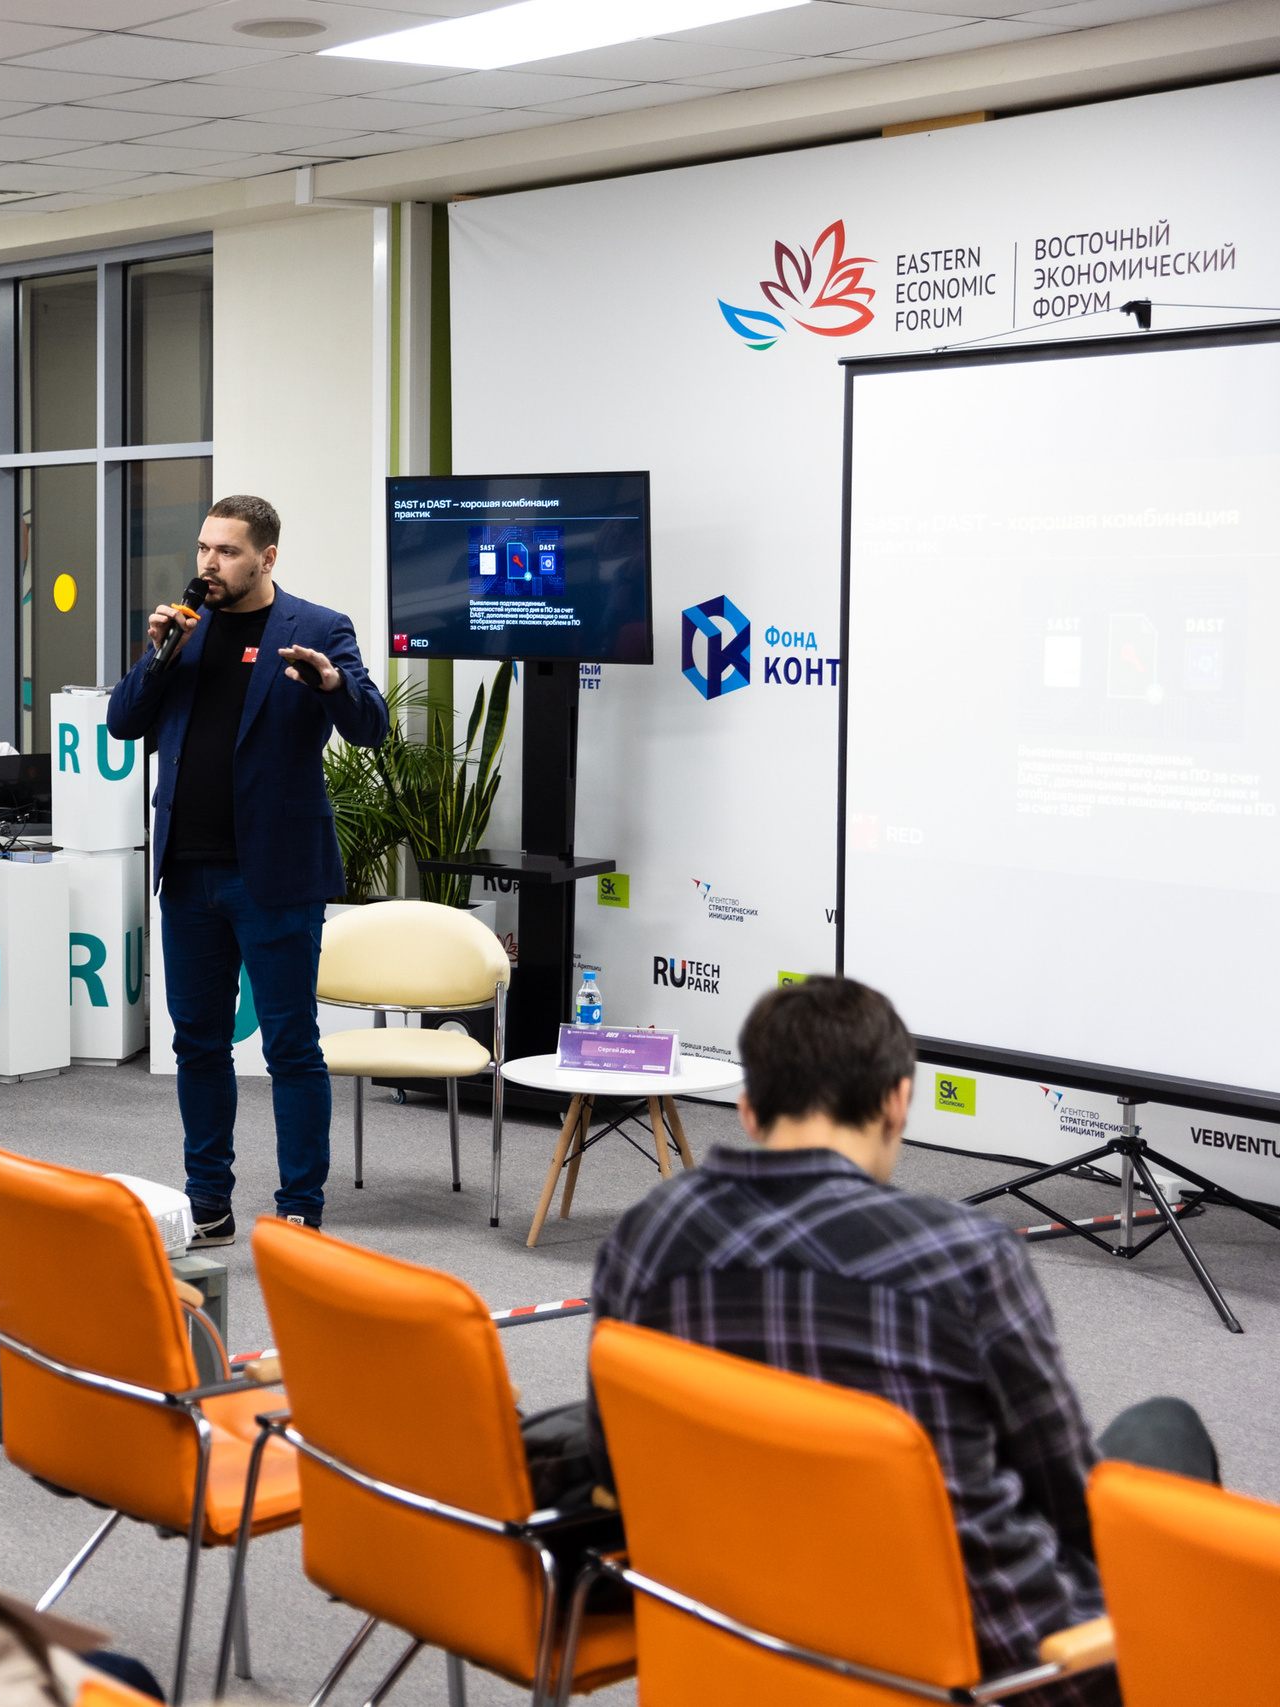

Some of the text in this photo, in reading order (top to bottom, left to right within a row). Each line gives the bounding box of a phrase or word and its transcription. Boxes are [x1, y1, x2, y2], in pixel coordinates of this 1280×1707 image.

[1034, 219, 1170, 261] ВОСТОЧНЫЙ
[897, 246, 980, 276] EASTERN
[1034, 242, 1236, 290] ЭКОНОМИЧЕСКИЙ
[896, 273, 996, 304] ECONOMIC
[1033, 291, 1110, 319] ФОРУМ
[895, 306, 962, 332] FORUM
[394, 500, 418, 509] SAST
[426, 500, 452, 509] DAST
[460, 501, 500, 510] хорошая
[502, 498, 559, 509] комбинация
[394, 510, 431, 519] практик
[1185, 618, 1225, 632] DAST
[410, 639, 429, 648] RED
[764, 625, 818, 651] Фонд
[764, 656, 841, 686] КОНТ
[579, 678, 601, 690] ТЕТ
[886, 825, 924, 845] RED
[601, 877, 616, 895] Sk
[708, 896, 740, 906] АГЕНТСТВО
[708, 904, 759, 917] СТРАТЕГИЧЕСКИХ
[708, 912, 744, 923] ИНИЦИАТИВ
[687, 960, 720, 978] TECH
[687, 976, 720, 995] PARK
[679, 1041, 702, 1050] орация
[939, 1079, 958, 1100] Sk
[938, 1098, 965, 1109] Сколково
[1060, 1106, 1100, 1120] АГЕНТСТВО
[1059, 1115, 1124, 1133] СТРАТЕГИЧЕСКИХ
[1060, 1124, 1105, 1139] ИНИЦИАТИВ
[1190, 1126, 1280, 1159] VEBVENTU
